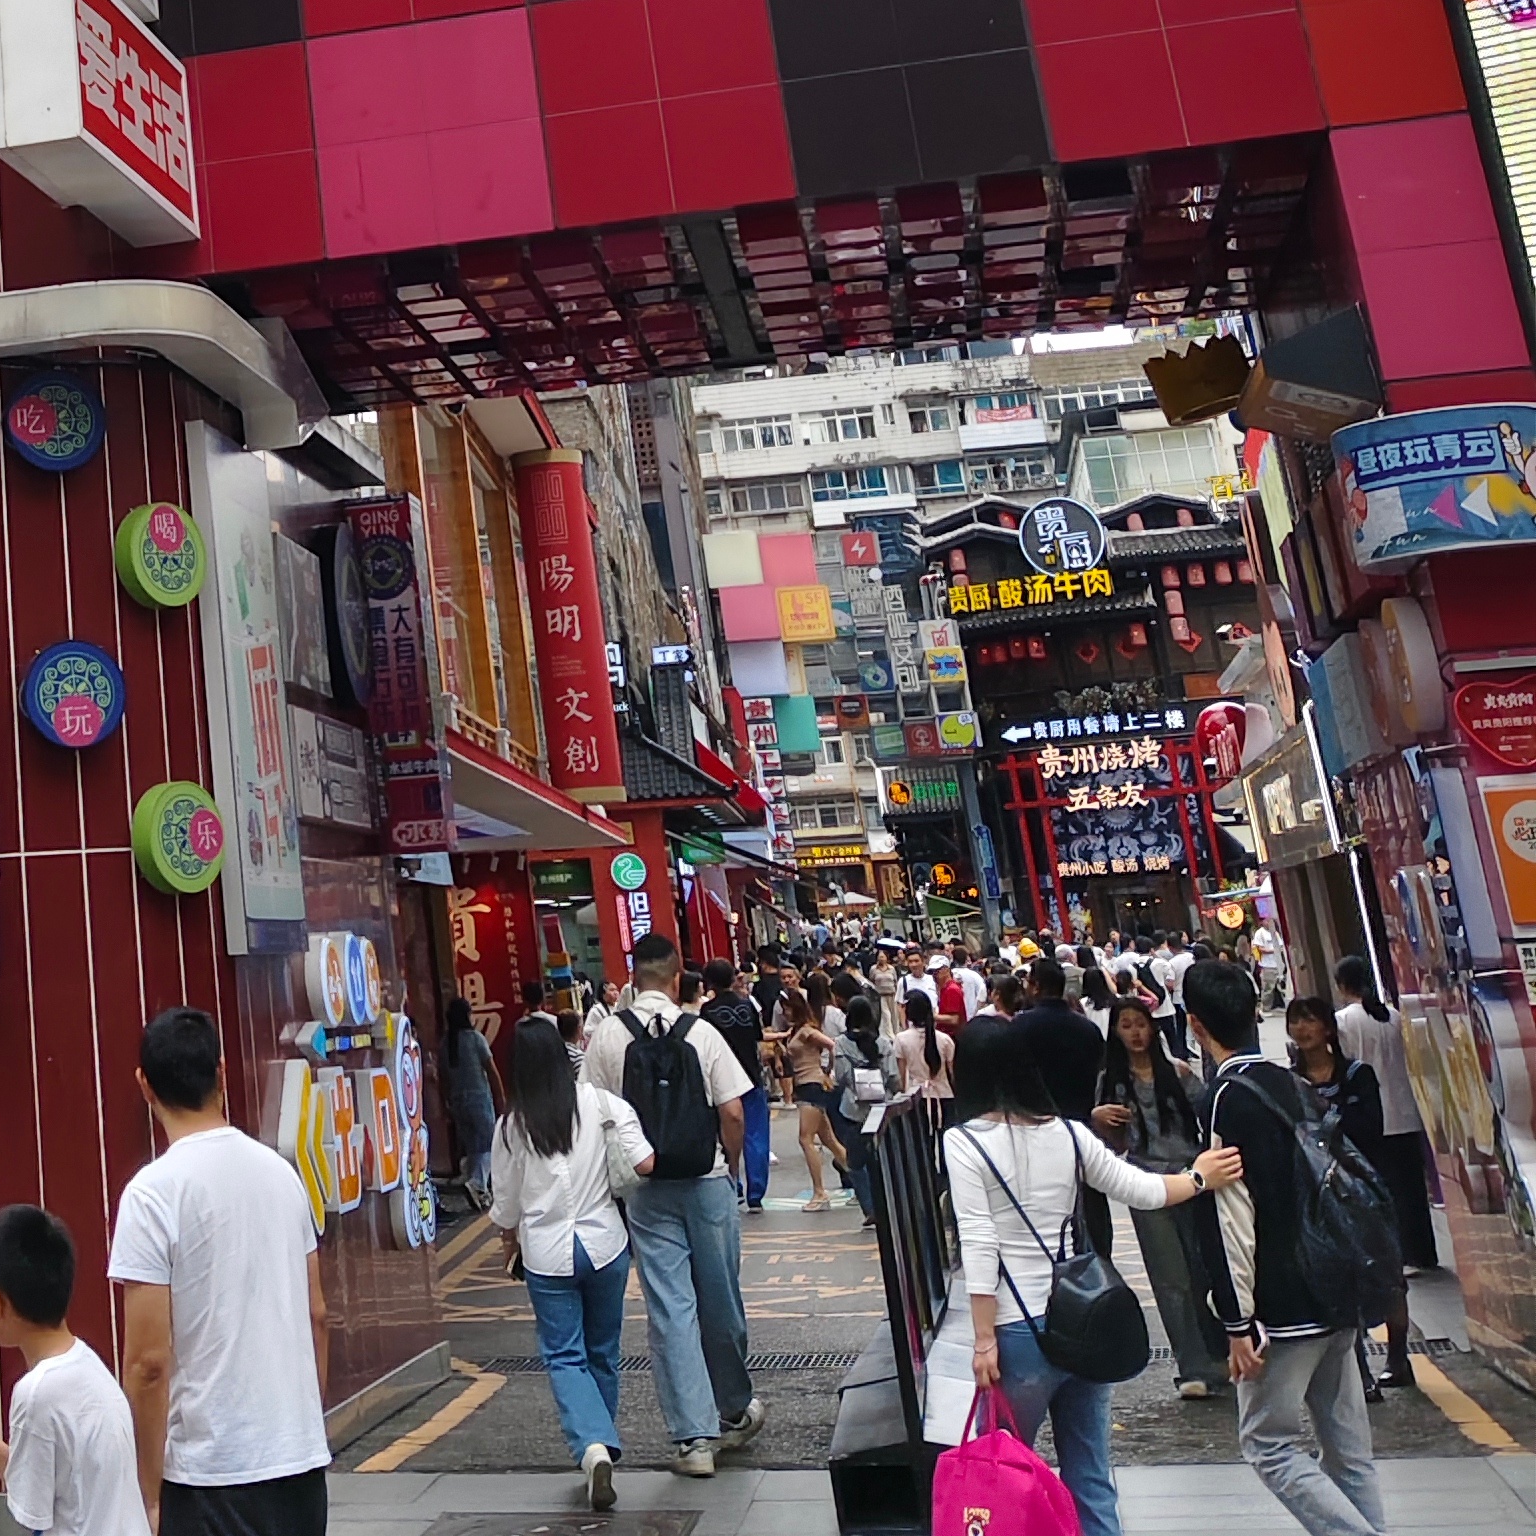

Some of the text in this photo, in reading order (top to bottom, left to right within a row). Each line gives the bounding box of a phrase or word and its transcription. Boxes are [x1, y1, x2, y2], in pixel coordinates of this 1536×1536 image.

[15, 404, 47, 436] 吃
[153, 510, 179, 545] 喝
[359, 508, 401, 527] QING
[61, 704, 95, 739] 玩
[1036, 734, 1163, 780] 贵州烧烤
[1065, 780, 1151, 814] 五条友
[196, 816, 219, 852] 乐
